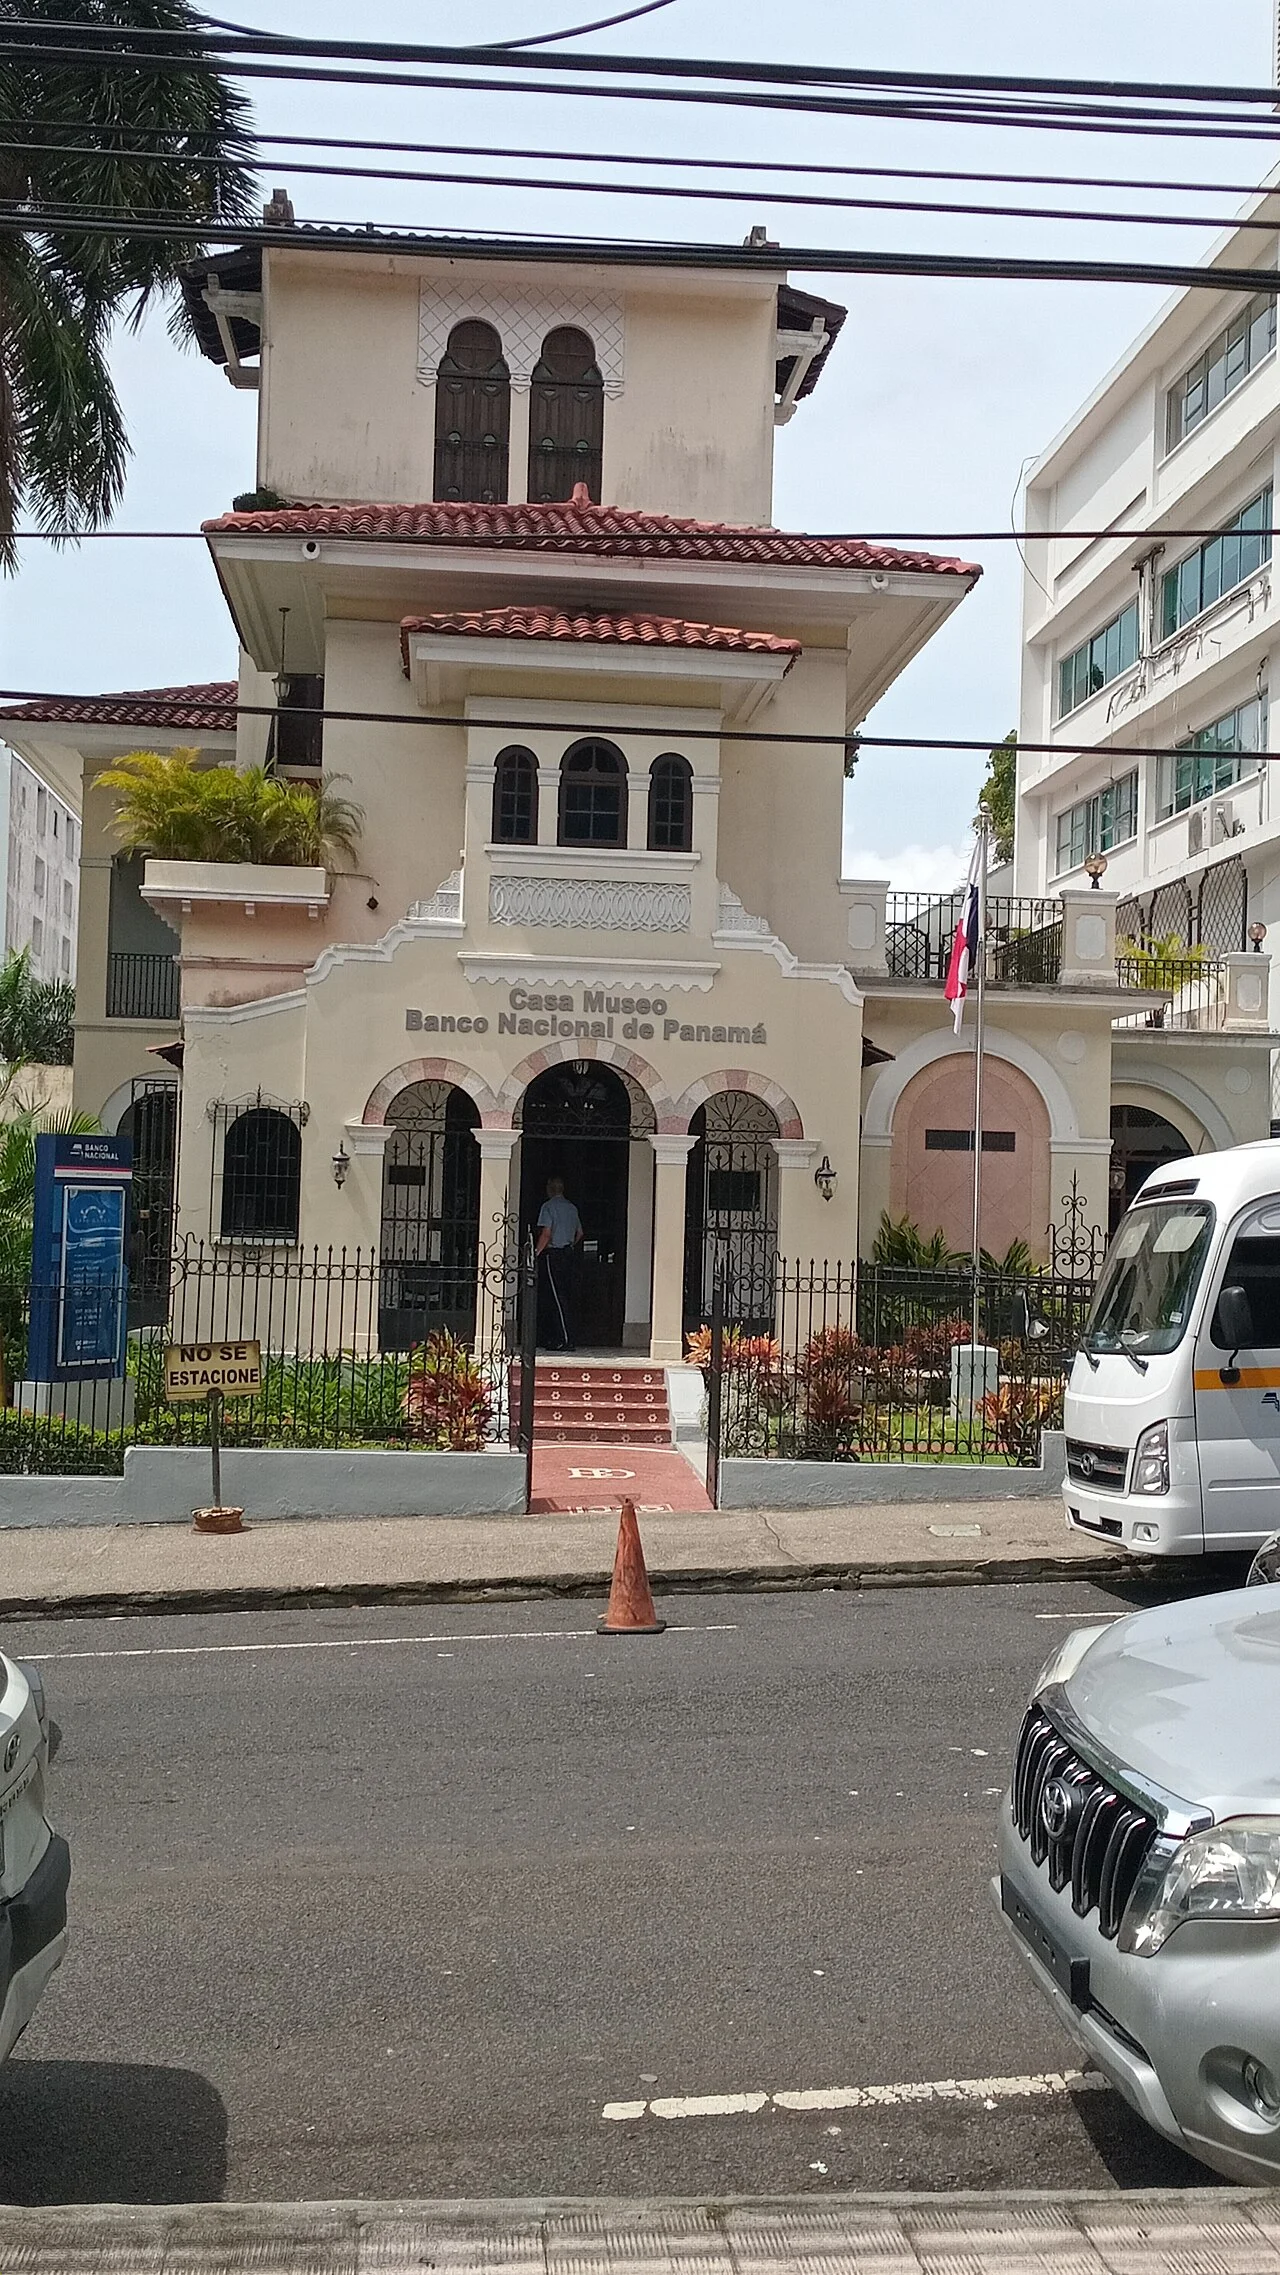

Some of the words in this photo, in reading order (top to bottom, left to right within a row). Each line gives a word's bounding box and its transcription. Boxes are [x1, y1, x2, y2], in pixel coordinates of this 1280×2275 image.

[509, 988, 574, 1012] Casa
[584, 990, 669, 1016] Museo
[405, 1008, 489, 1034] Banco
[498, 1011, 614, 1038] Nacional
[622, 1017, 655, 1040] de
[663, 1019, 767, 1045] Panamá
[84, 1144, 109, 1152] BANCO
[84, 1152, 119, 1160] NACIONAL
[180, 1347, 212, 1363] NO
[220, 1345, 247, 1361] SE
[170, 1368, 259, 1387] ESTACIONE
